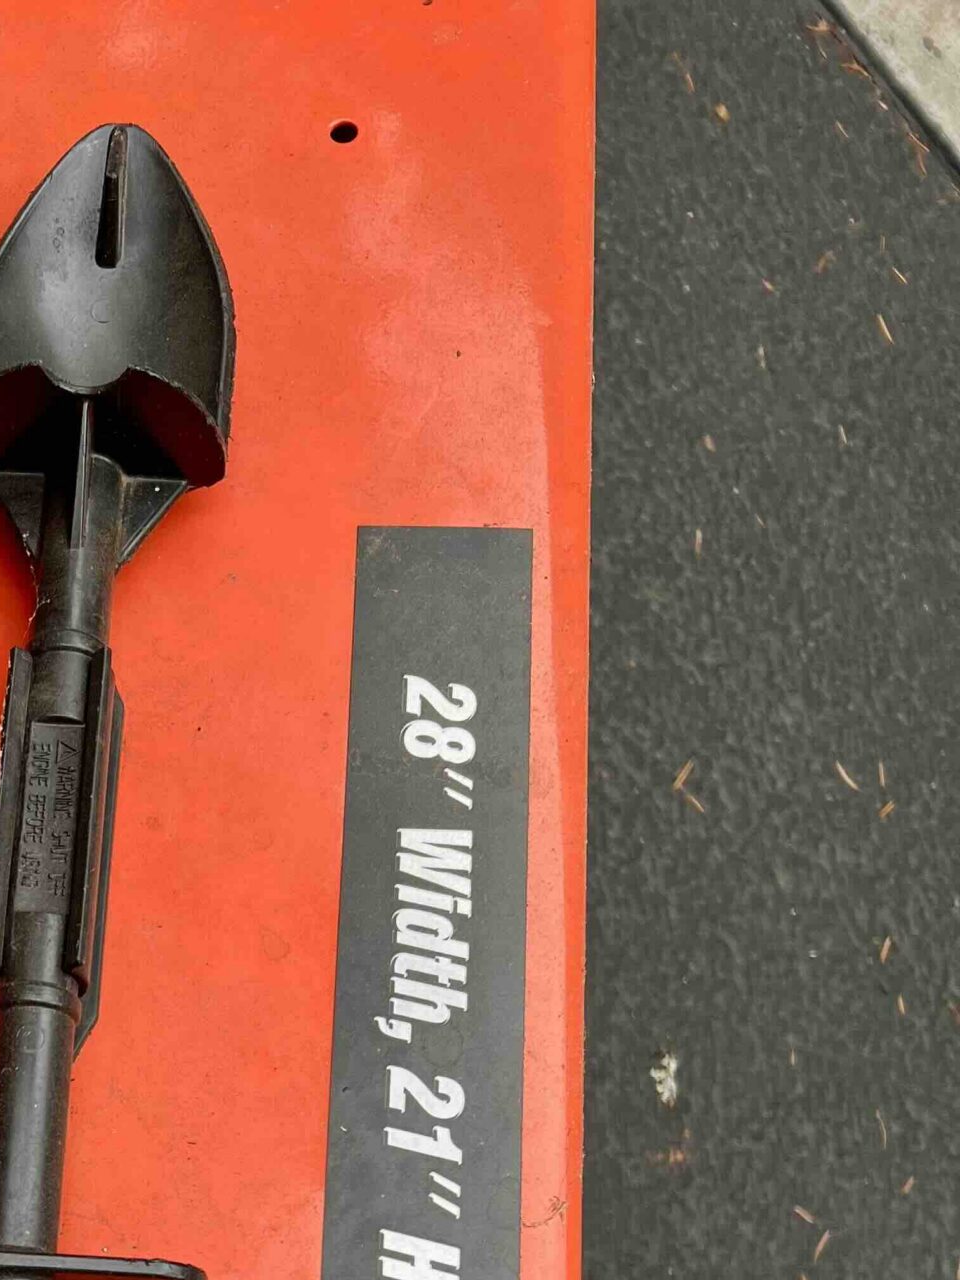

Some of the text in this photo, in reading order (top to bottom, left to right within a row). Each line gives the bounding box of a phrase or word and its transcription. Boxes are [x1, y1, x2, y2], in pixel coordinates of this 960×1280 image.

[29, 743, 52, 787] ENGINE
[400, 674, 478, 810] 28"
[23, 794, 46, 844] BEFORE
[50, 831, 70, 865] SHUT
[47, 872, 67, 897] OFF
[374, 828, 473, 1044] Width,
[384, 1065, 466, 1219] 21"
